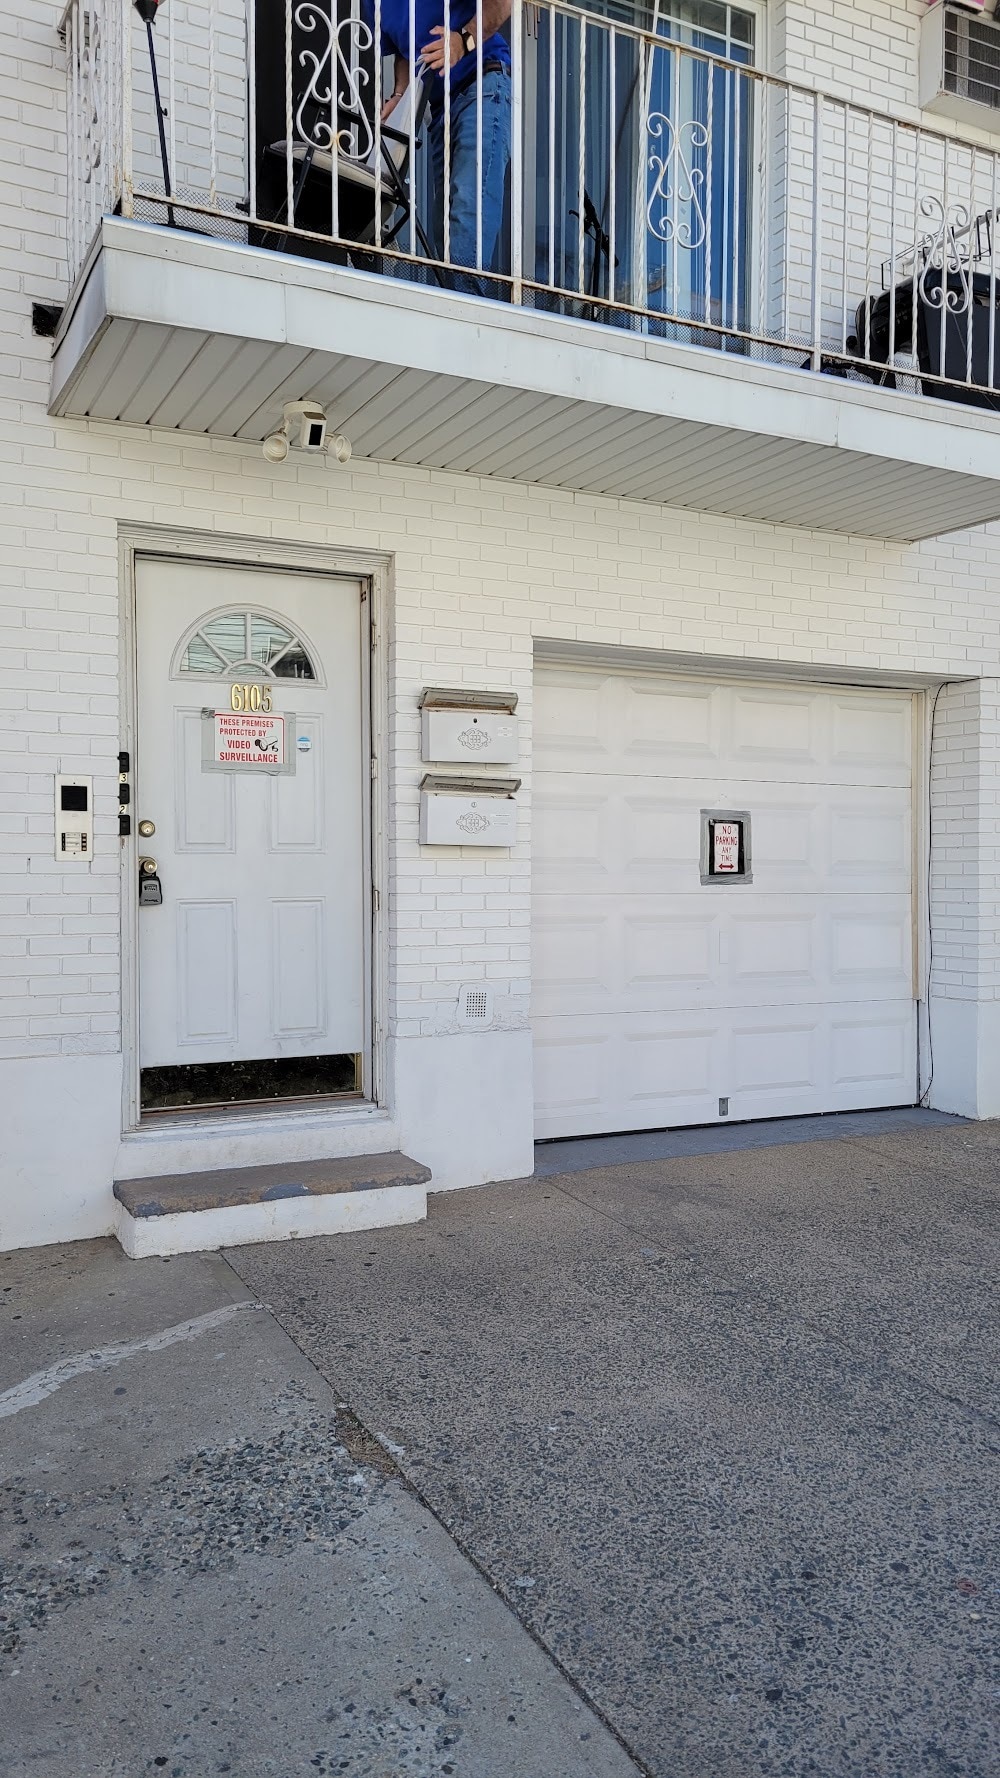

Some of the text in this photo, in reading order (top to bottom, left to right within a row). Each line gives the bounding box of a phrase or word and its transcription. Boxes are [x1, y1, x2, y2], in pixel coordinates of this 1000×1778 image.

[231, 683, 272, 713] 6105
[220, 718, 274, 728] THESE PREMISES
[220, 728, 256, 737] PROTECTED
[227, 740, 250, 750] VIDEO
[220, 752, 278, 762] SURVEILLANCE
[121, 774, 126, 782] 3
[119, 806, 126, 814] 2
[722, 826, 732, 834] NO
[716, 836, 738, 846] PARKING
